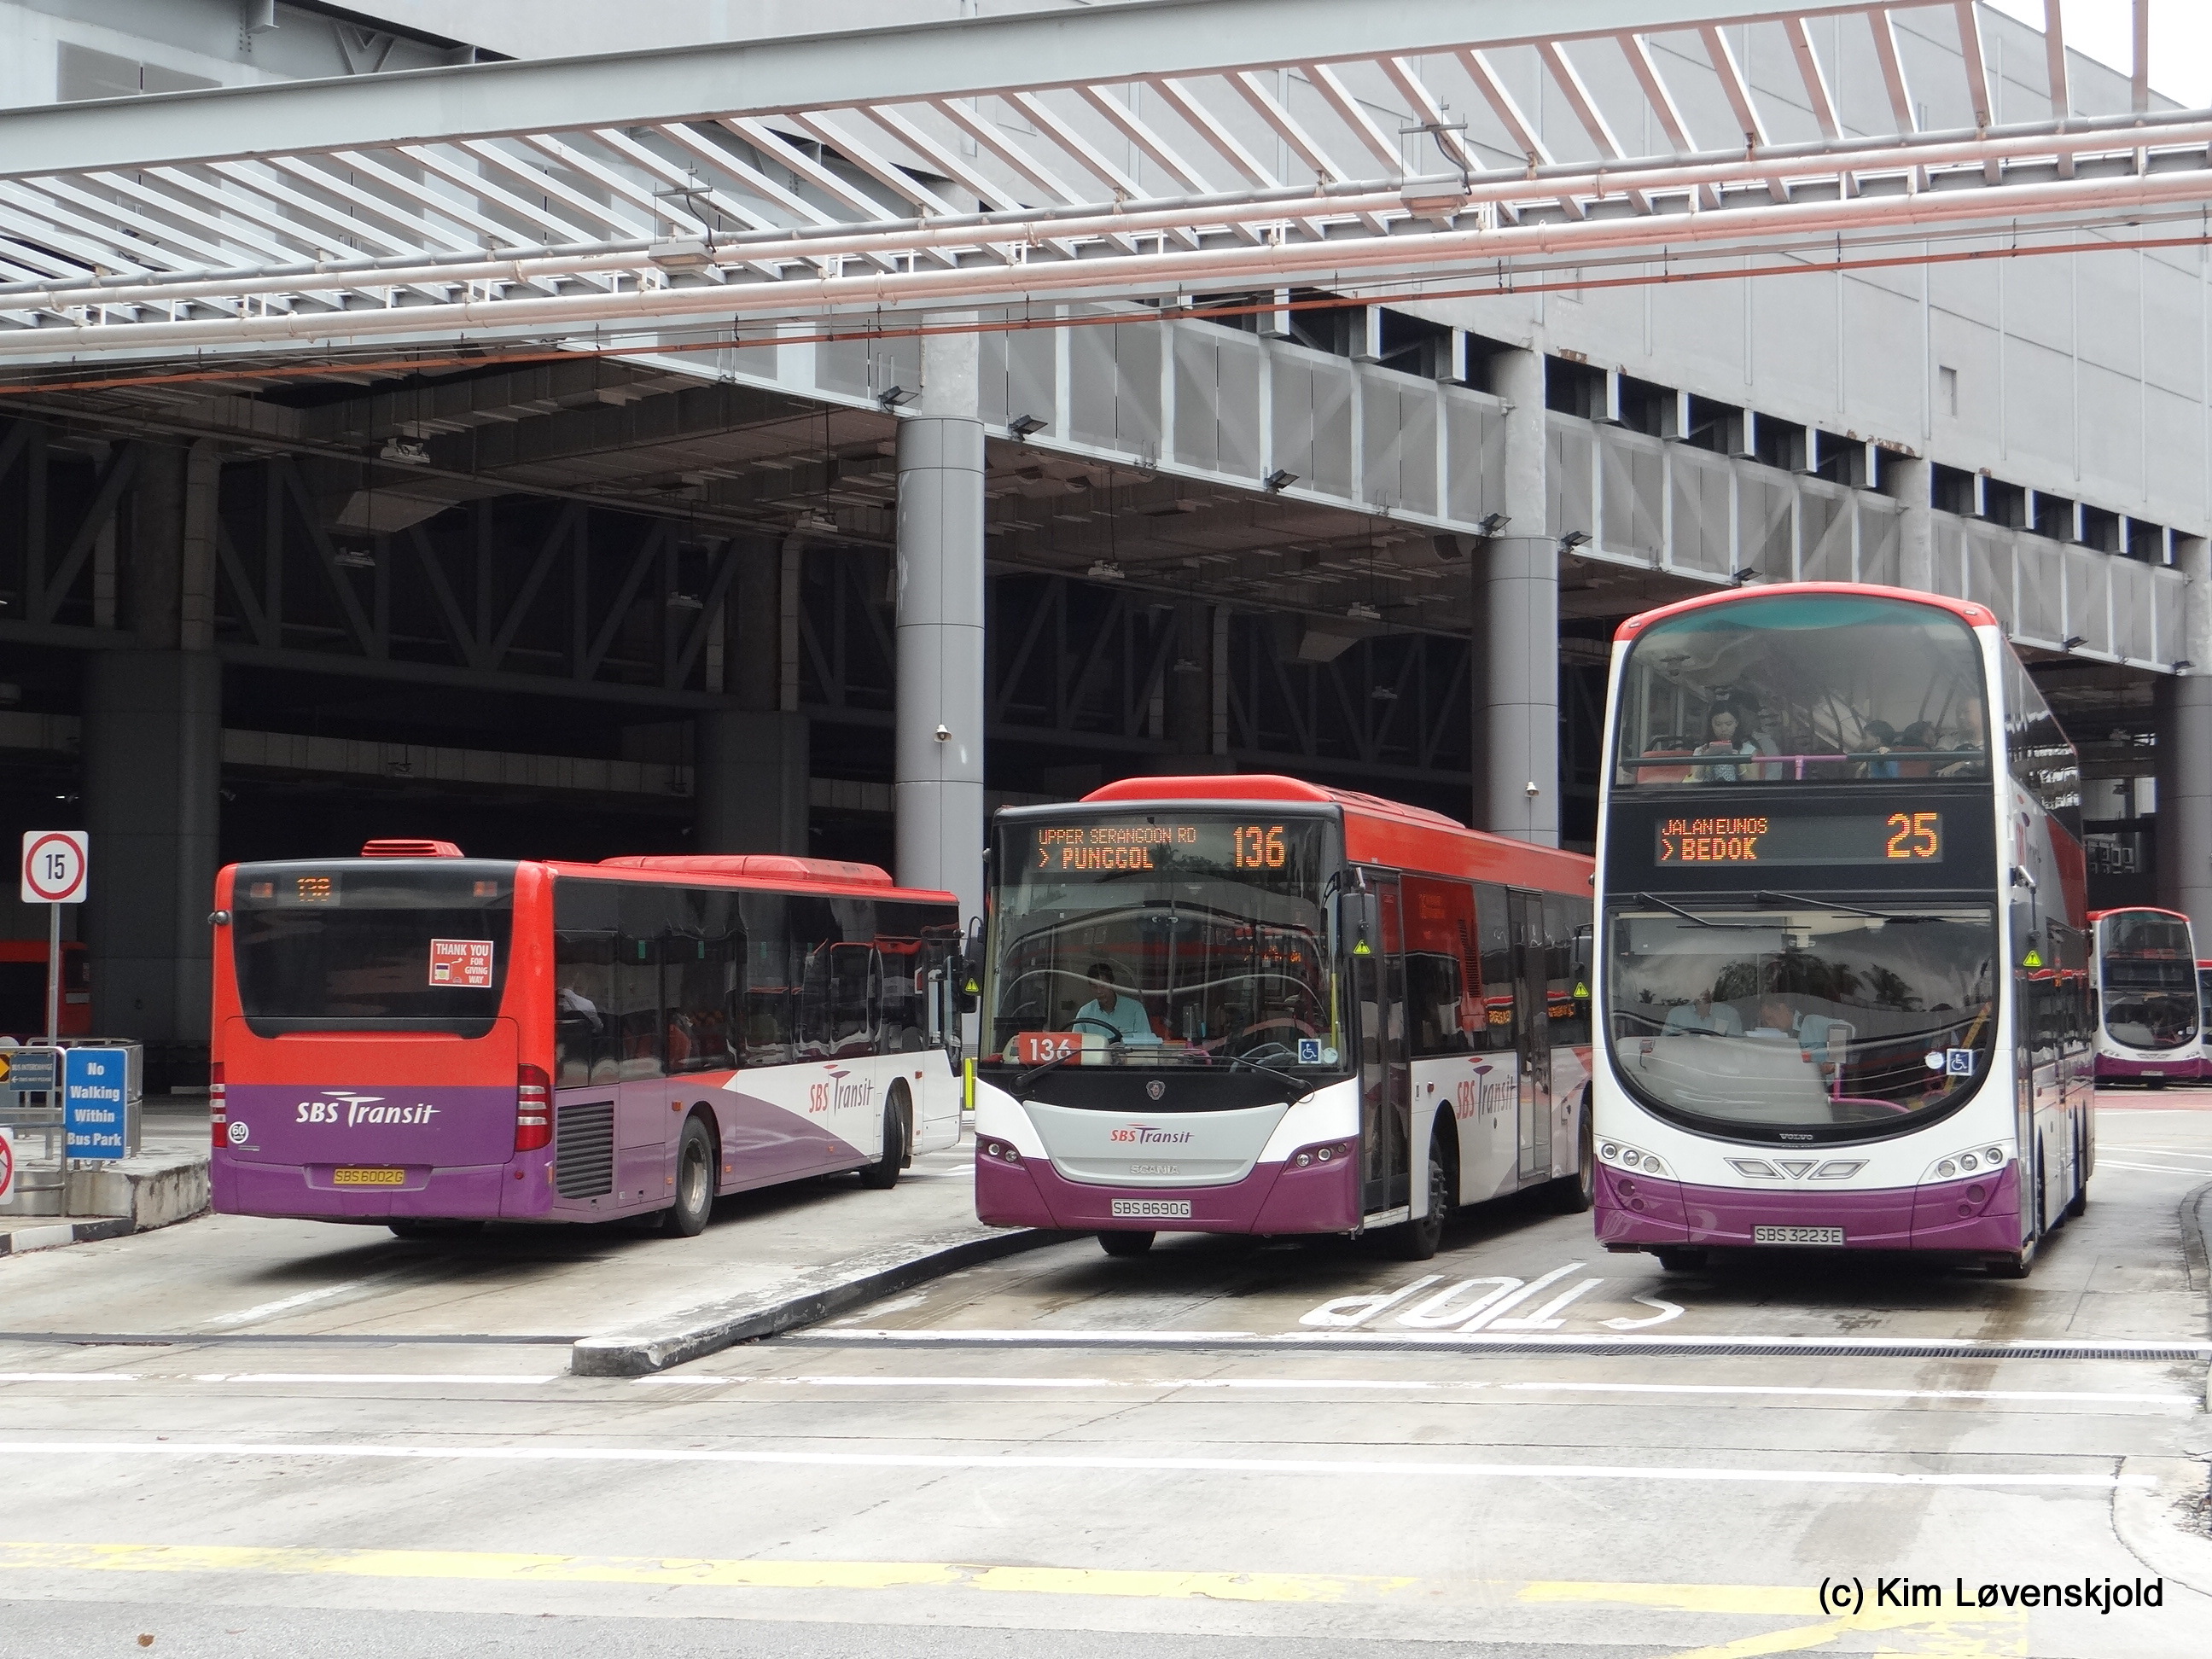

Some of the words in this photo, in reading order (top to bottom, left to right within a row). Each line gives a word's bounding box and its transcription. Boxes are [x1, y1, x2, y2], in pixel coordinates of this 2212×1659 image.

[1662, 818, 1713, 835] JALAN
[1715, 818, 1767, 835] EUNOS
[1887, 812, 1937, 858] 25
[1039, 829, 1083, 845] UPPER
[1090, 828, 1171, 844] SERANGOON
[1178, 827, 1196, 843] RD
[1233, 826, 1284, 867] 136
[1681, 837, 1758, 860] BEDOK
[45, 853, 66, 880] 15
[1062, 847, 1154, 869] PUNGGOL
[435, 943, 468, 956] THANK
[470, 944, 489, 957] YOU
[470, 957, 484, 966] FOR
[464, 966, 488, 975] GIVING
[469, 975, 484, 984] WAY
[1030, 1038, 1072, 1062] 136
[87, 1062, 104, 1076] No
[70, 1086, 120, 1102] Walking
[809, 1082, 829, 1113] SBS
[829, 1070, 875, 1116] Transit
[1457, 1080, 1475, 1120] SBS
[1473, 1065, 1516, 1124] Transit
[74, 1109, 115, 1123] Within
[296, 1102, 339, 1124] SBS
[335, 1097, 441, 1127] Transit
[232, 1125, 245, 1135] 60
[1110, 1129, 1136, 1142] SBS
[1134, 1127, 1195, 1144] Transit
[67, 1132, 90, 1146] Bus
[93, 1132, 122, 1147] Park
[1130, 1165, 1179, 1175] SCANIA
